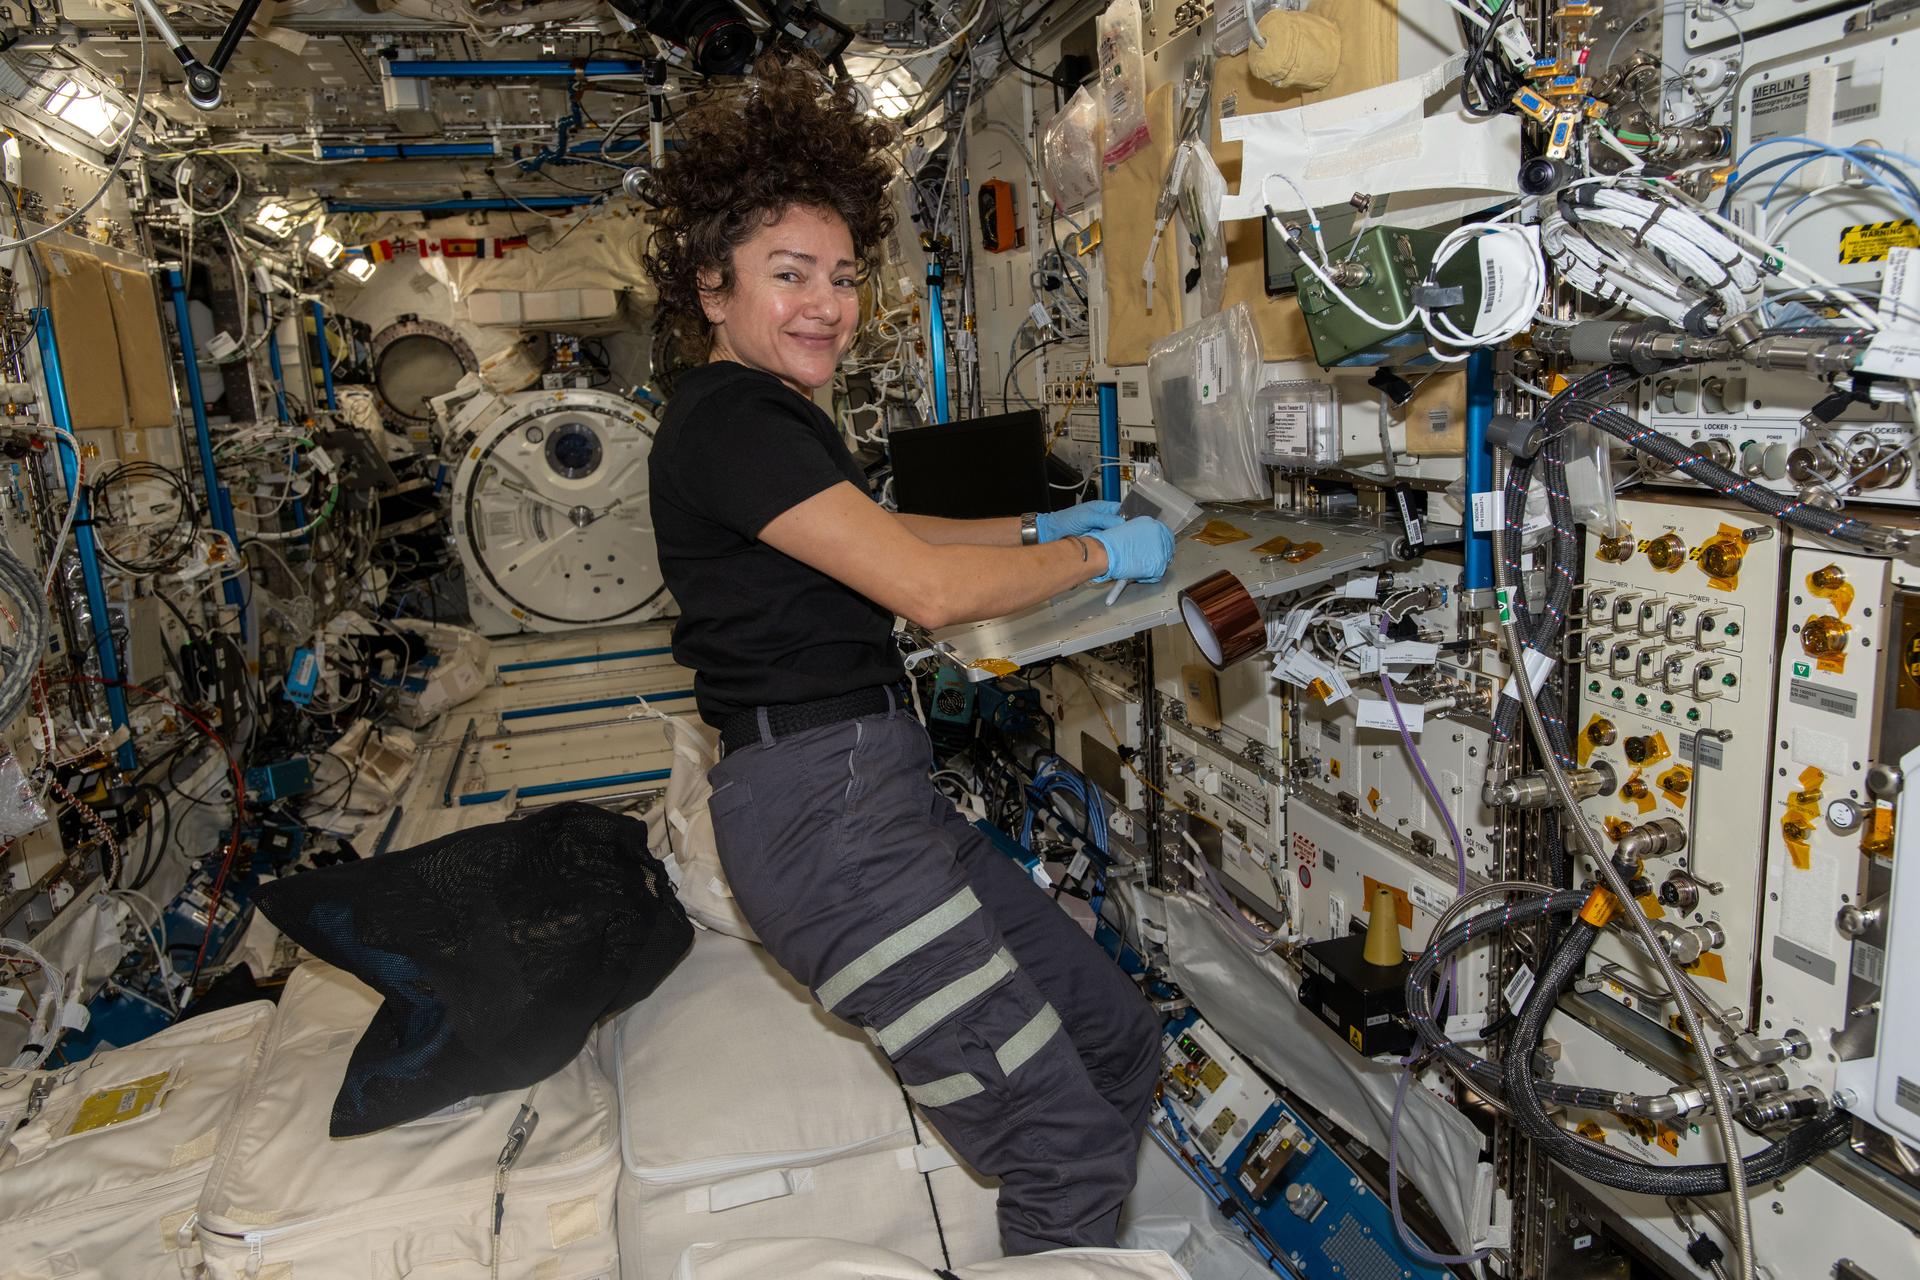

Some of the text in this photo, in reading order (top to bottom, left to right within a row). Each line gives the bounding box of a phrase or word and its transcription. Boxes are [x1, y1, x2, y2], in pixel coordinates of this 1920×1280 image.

[1752, 75, 1811, 99] MERLIN 5
[1792, 92, 1809, 104] Expe
[1860, 227, 1903, 239] WARNING
[1869, 427, 1903, 435] LOCKER
[1609, 579, 1629, 589] POWER
[1688, 593, 1710, 603] POWER
[1463, 835, 1489, 855] RACK POWER
